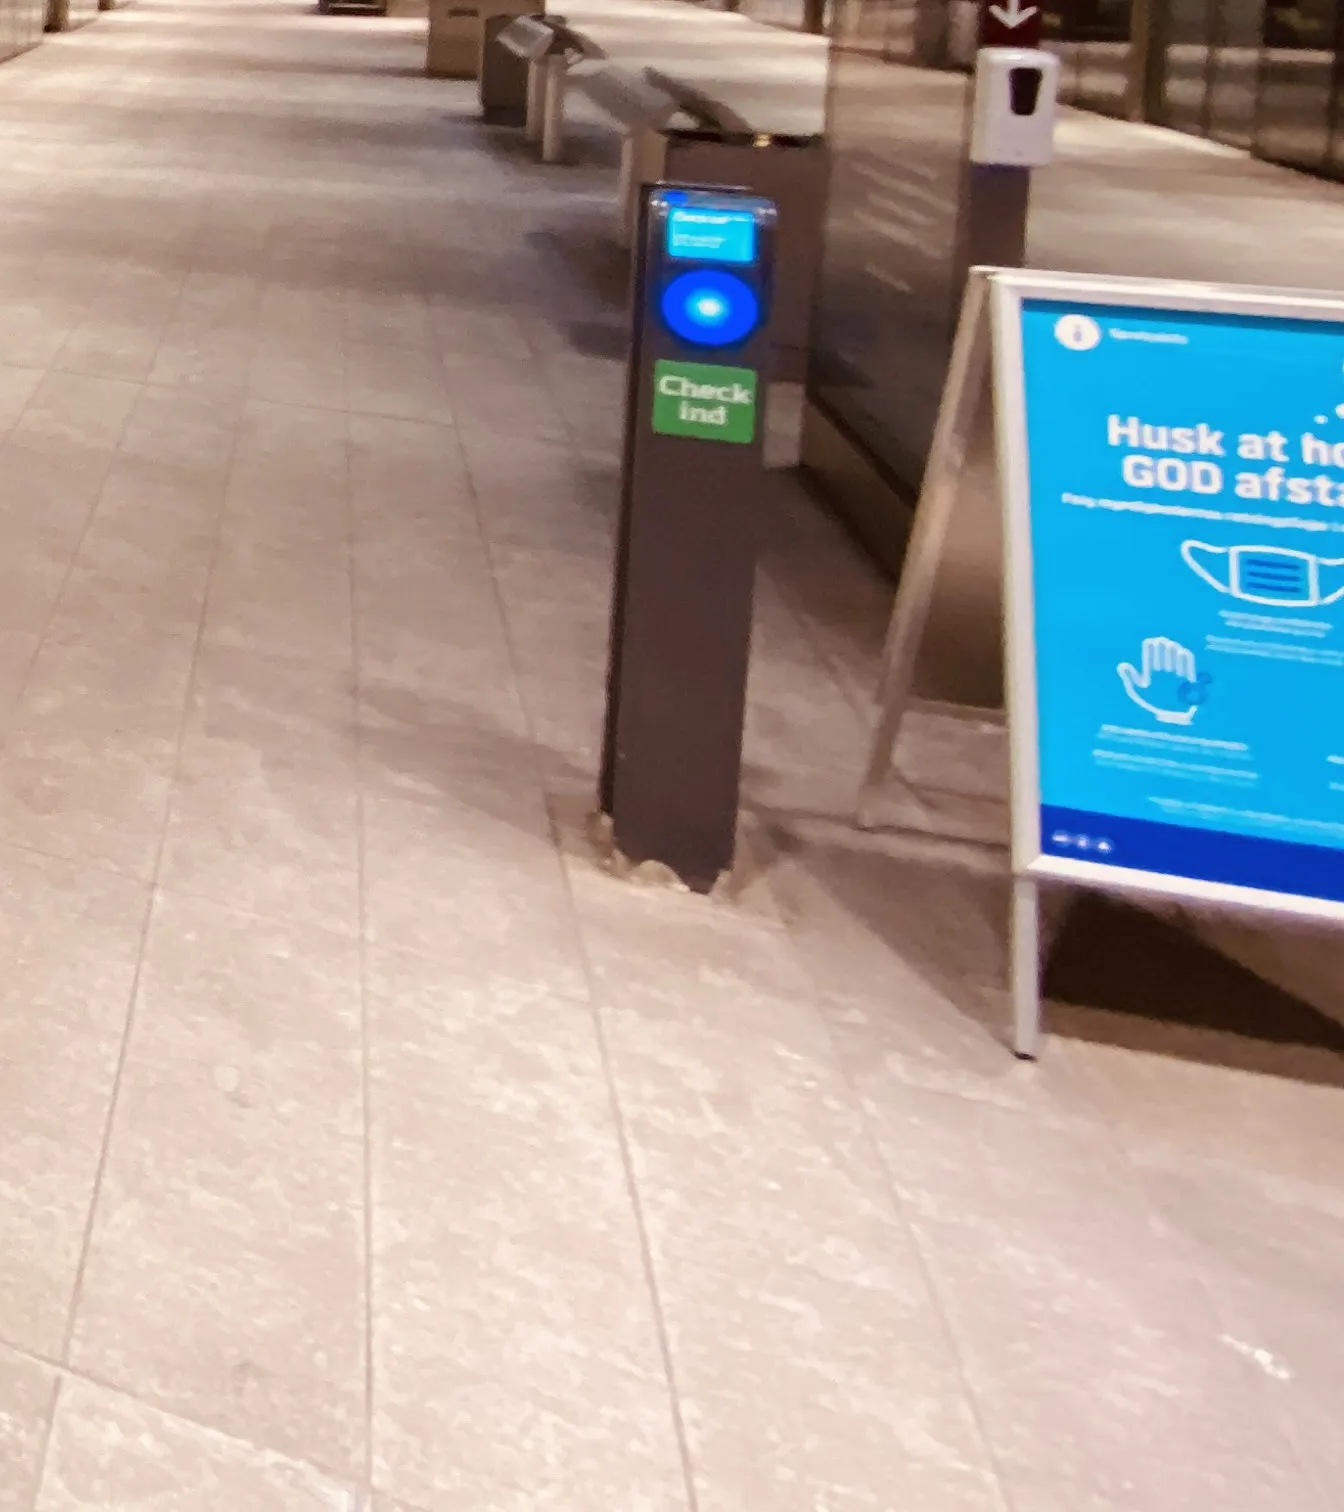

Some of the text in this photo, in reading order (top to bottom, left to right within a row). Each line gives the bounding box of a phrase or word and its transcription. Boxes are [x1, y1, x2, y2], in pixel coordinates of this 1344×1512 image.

[659, 375, 752, 405] Check
[679, 401, 728, 426] ind
[1107, 414, 1226, 458] Husk
[1237, 430, 1290, 463] at
[1122, 454, 1344, 508] GOD afst
